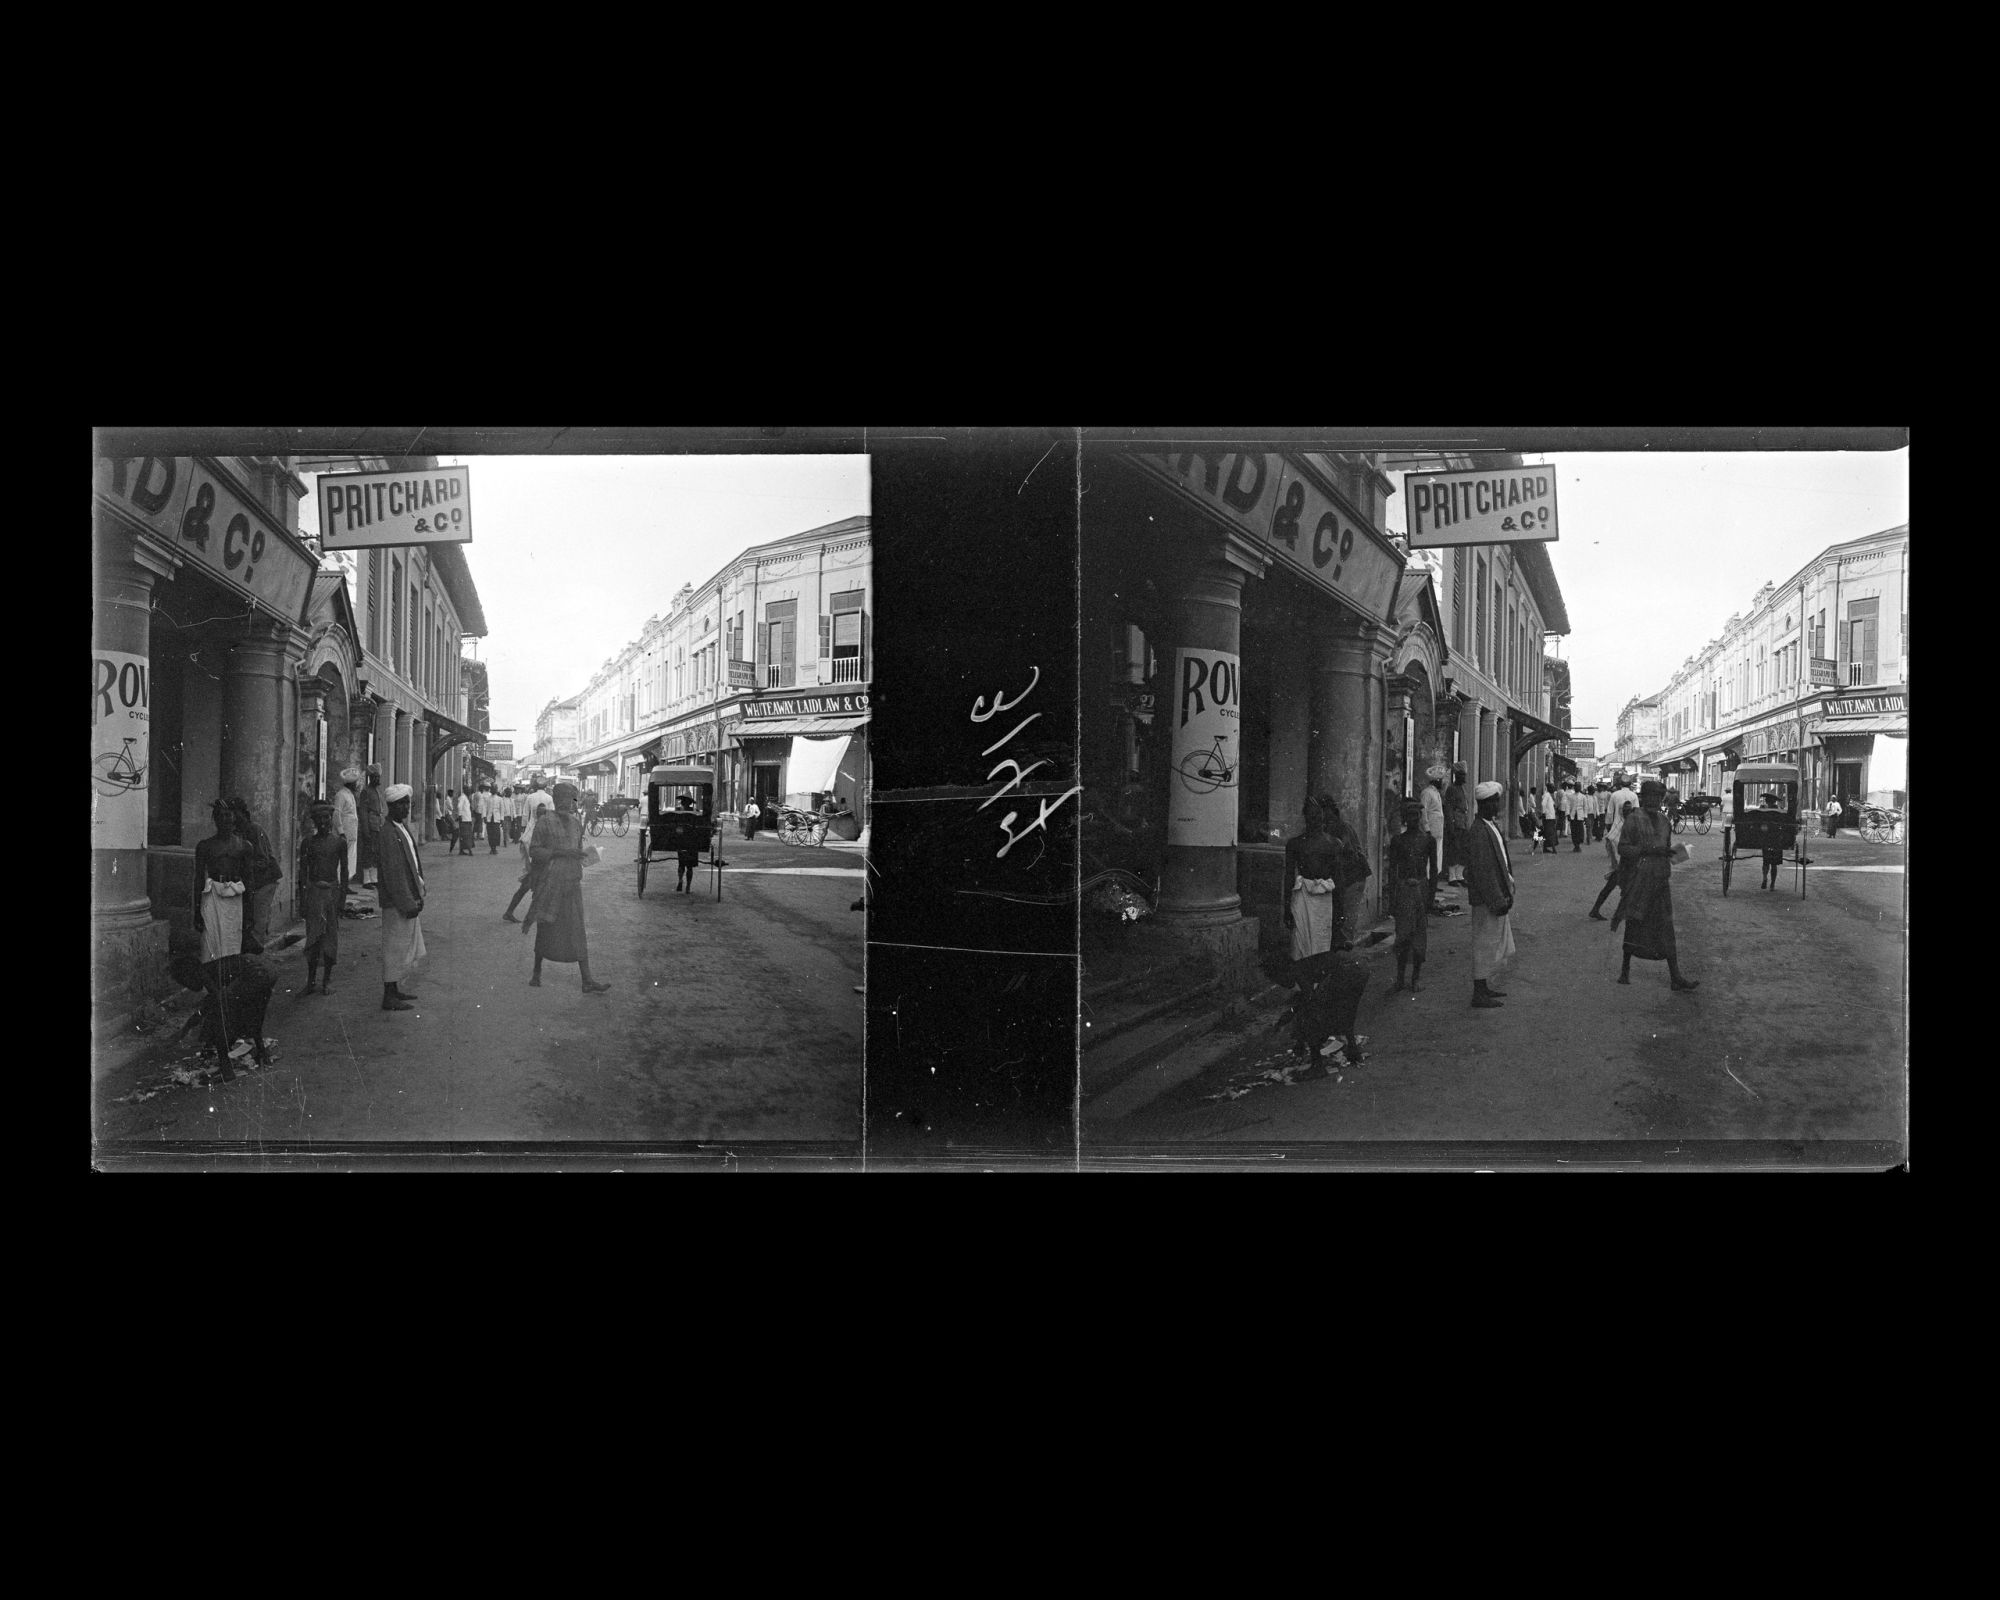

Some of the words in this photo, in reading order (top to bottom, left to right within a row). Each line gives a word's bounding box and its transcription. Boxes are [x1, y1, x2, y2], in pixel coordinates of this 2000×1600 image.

[182, 482, 215, 553] &
[326, 478, 462, 536] PRITCHARD
[414, 518, 434, 533] &
[1272, 480, 1305, 551] &
[1413, 476, 1548, 535] PRITCHARD
[1501, 516, 1520, 532] &
[796, 697, 840, 714] LAIDLAW
[844, 696, 853, 711] &
